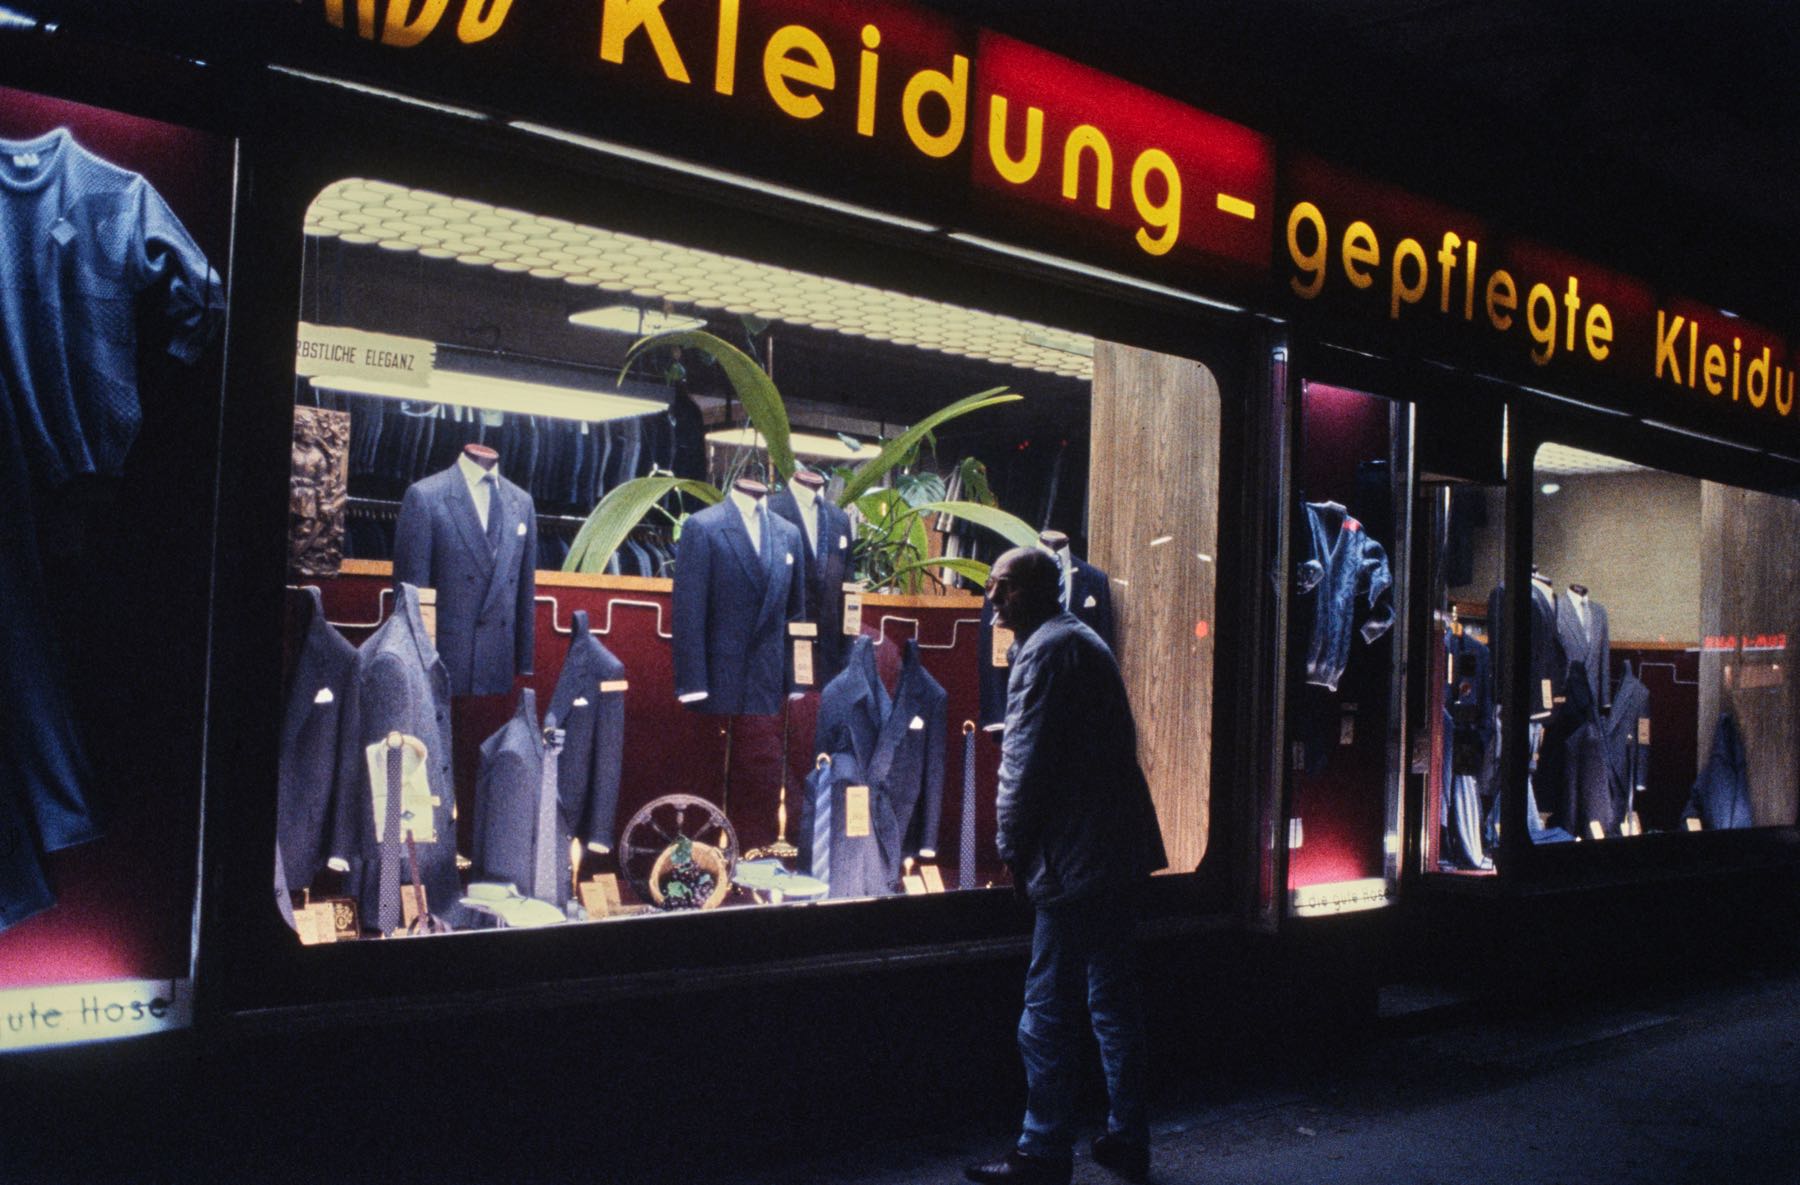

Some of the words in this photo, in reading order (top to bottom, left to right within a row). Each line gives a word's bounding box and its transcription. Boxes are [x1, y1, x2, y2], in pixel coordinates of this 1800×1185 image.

[600, 0, 1184, 257] Kleidung
[1286, 200, 1614, 366] gepflegte
[1655, 309, 1795, 416] Kleidu
[365, 349, 415, 371] ELEGANZ
[81, 996, 167, 1026] Hose
